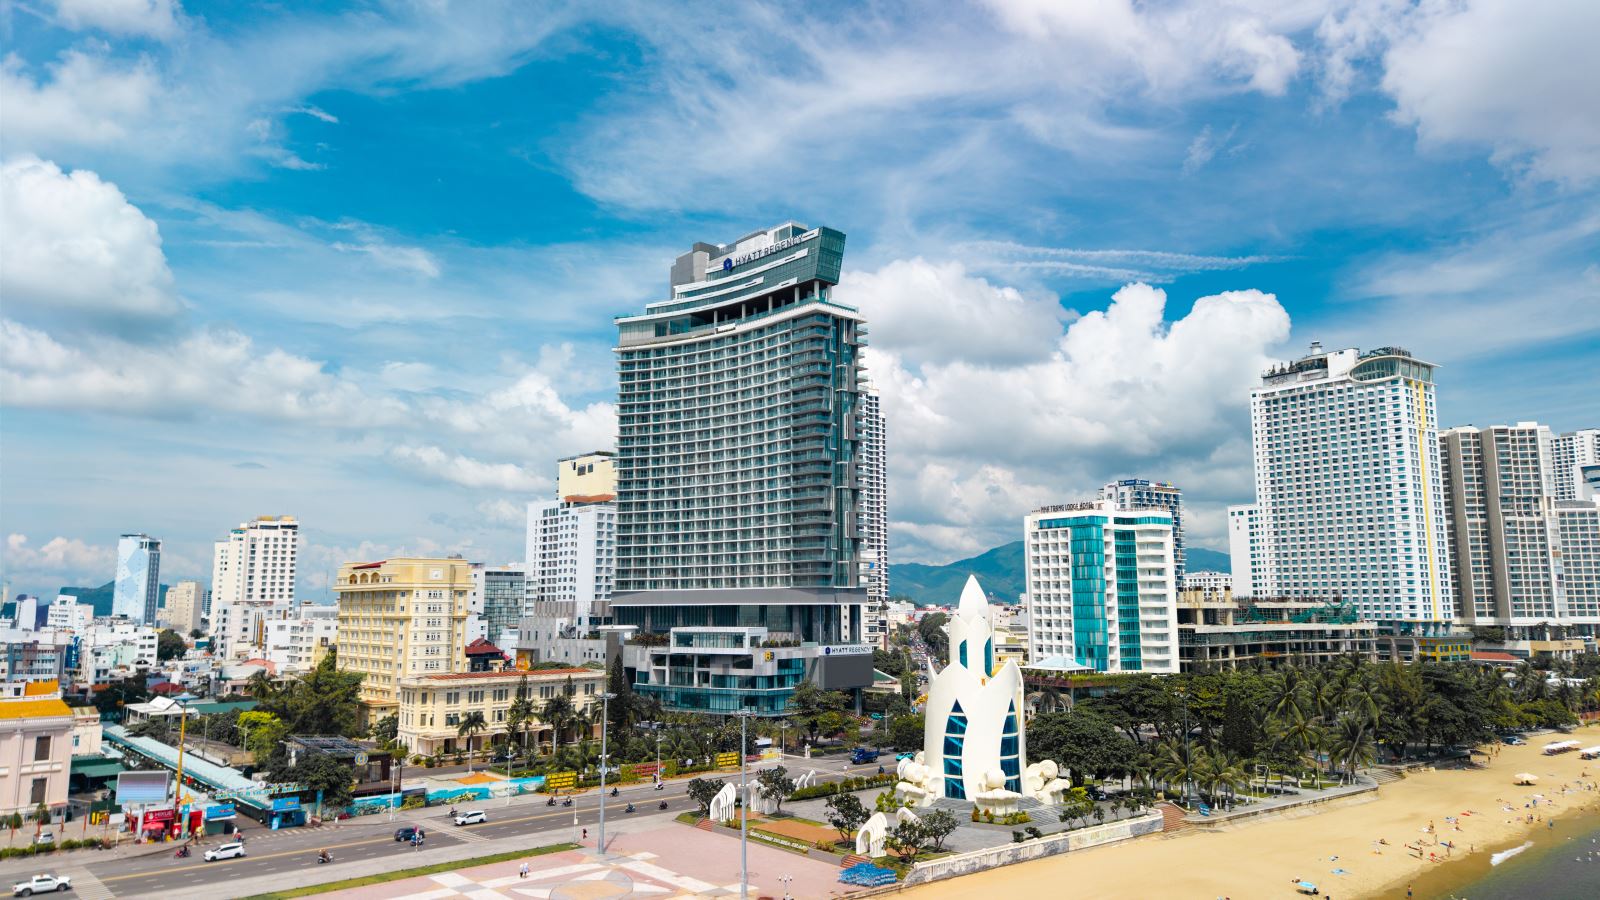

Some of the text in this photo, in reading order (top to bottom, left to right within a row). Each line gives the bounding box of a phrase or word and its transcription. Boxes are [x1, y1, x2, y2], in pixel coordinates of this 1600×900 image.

[736, 235, 803, 265] HYATT REGENCY
[1050, 504, 1064, 512] TRANG
[1065, 503, 1079, 511] LODGE
